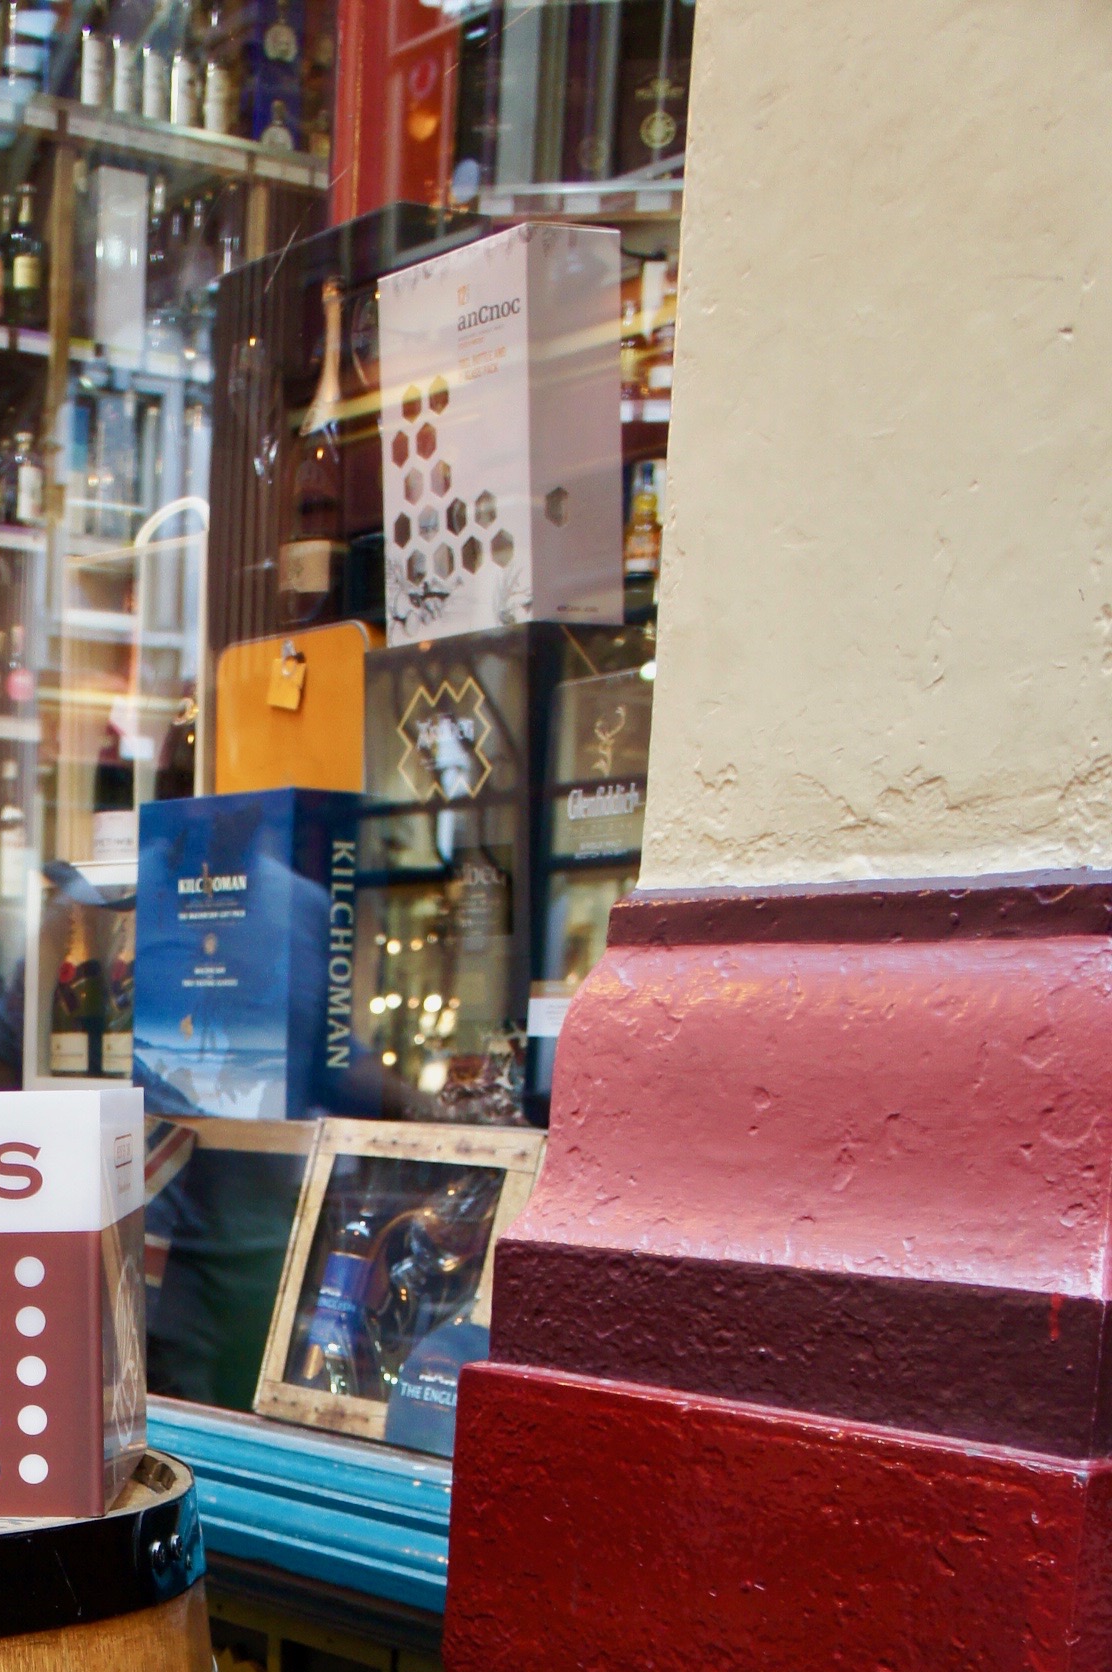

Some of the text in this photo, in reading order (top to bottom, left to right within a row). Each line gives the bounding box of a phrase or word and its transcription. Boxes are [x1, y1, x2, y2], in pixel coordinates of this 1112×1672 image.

[457, 297, 521, 332] anCnoc
[326, 840, 356, 1069] KILCHOMAN
[400, 1381, 423, 1400] THE
